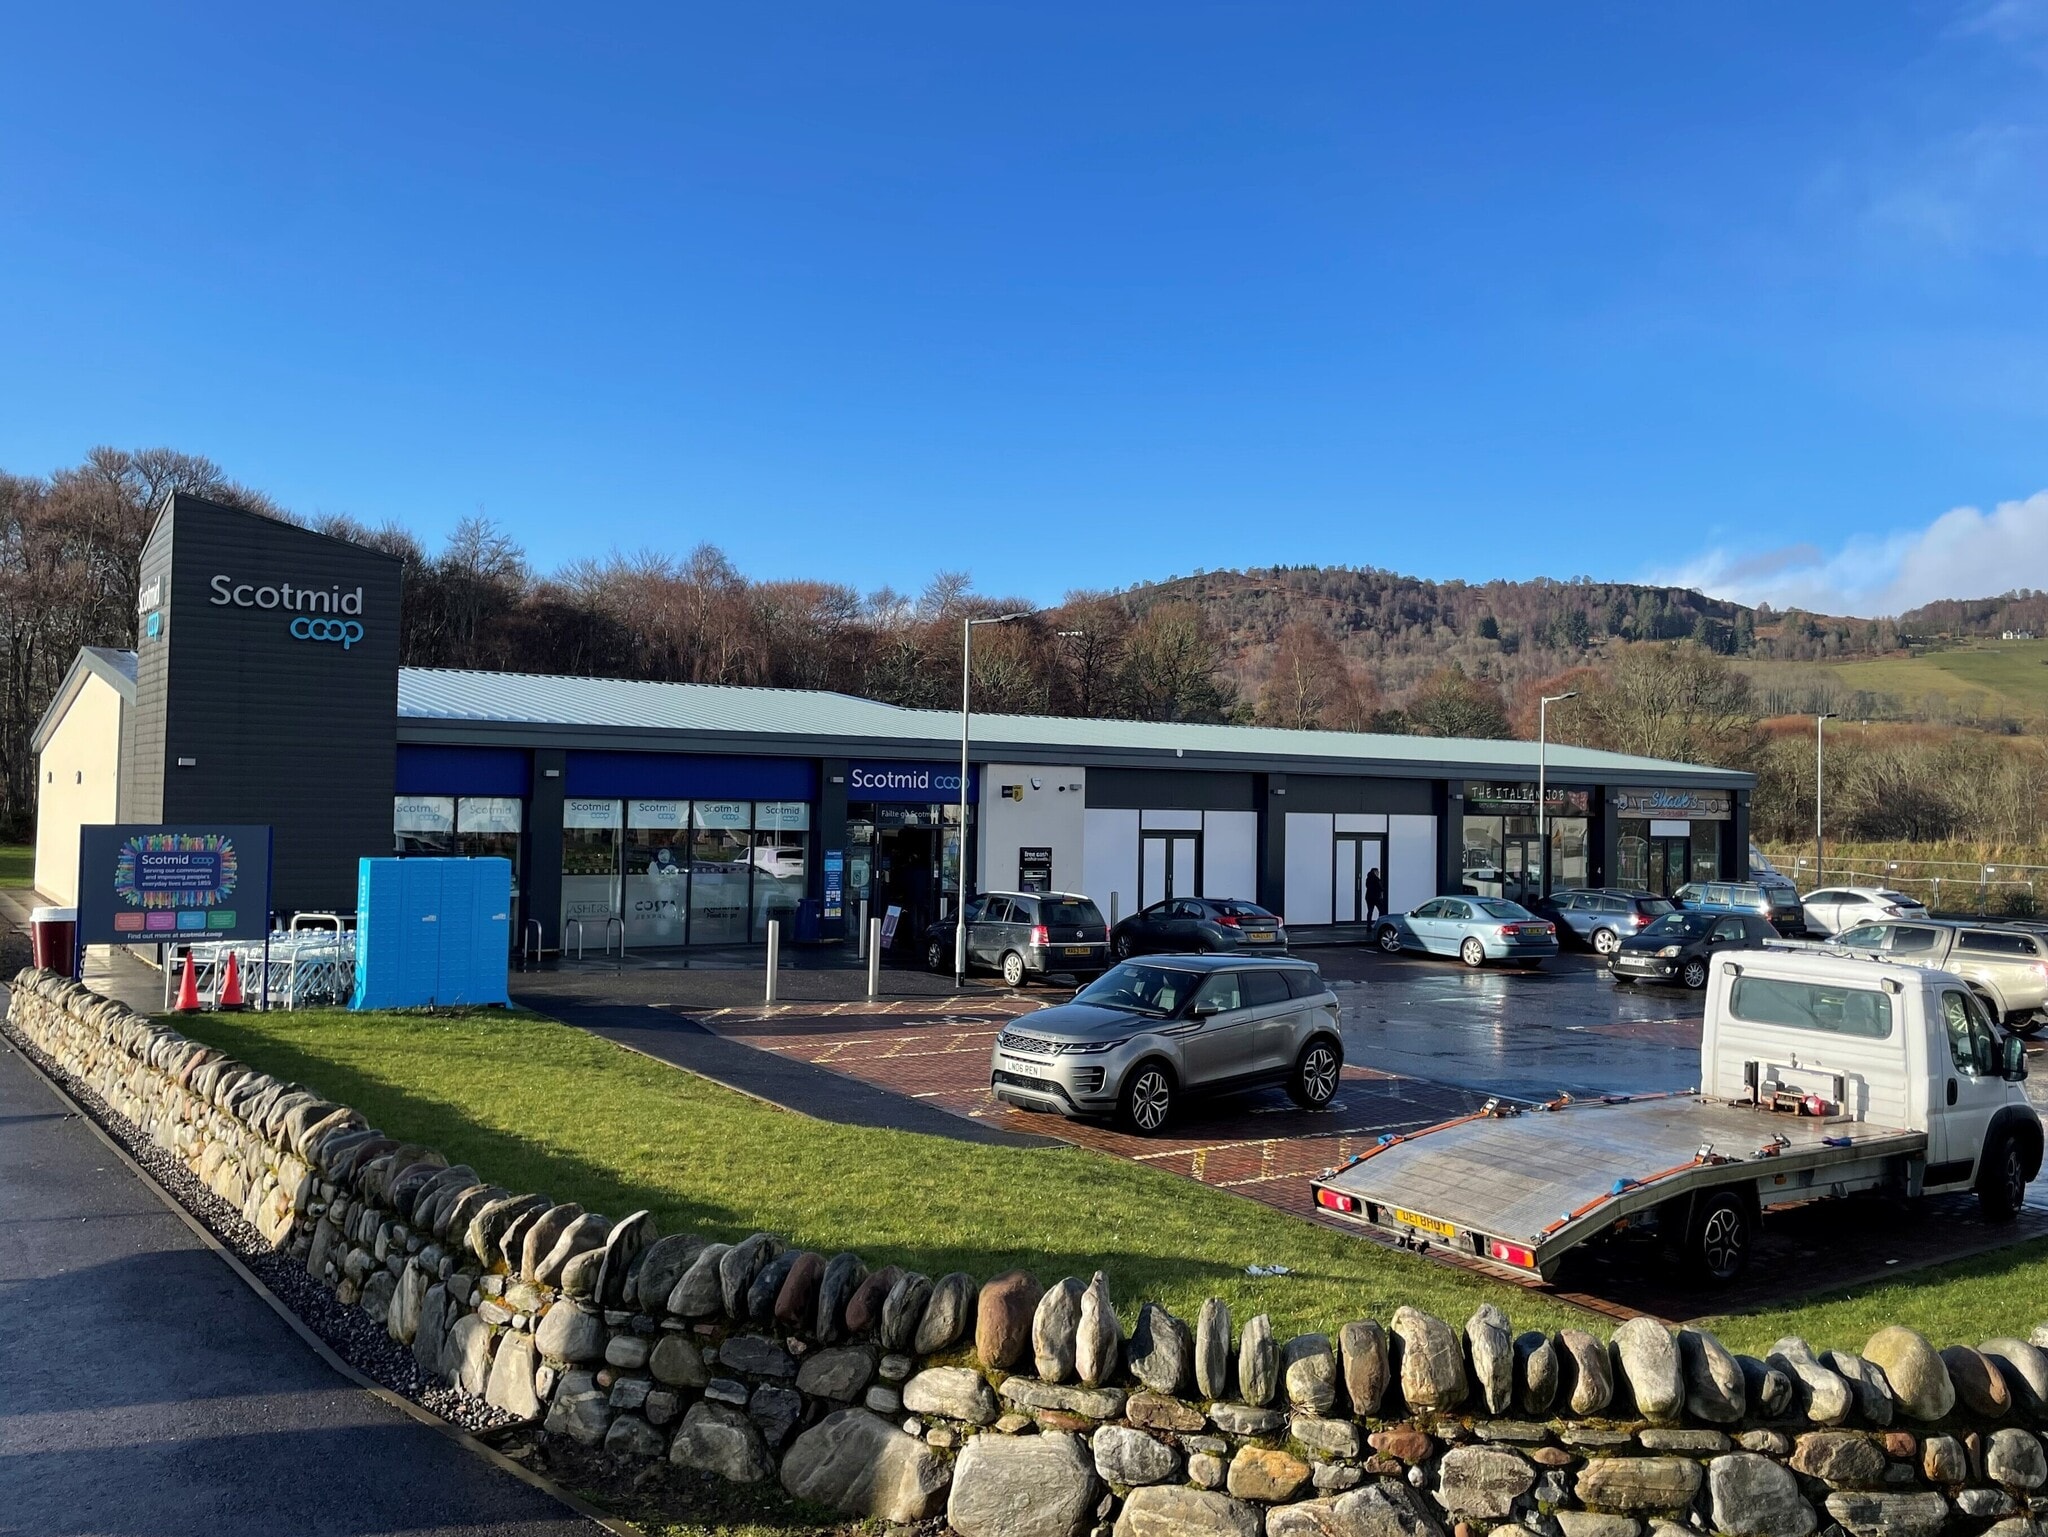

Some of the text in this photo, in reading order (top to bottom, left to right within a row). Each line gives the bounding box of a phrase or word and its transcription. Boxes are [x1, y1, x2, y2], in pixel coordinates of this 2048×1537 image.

[209, 574, 363, 615] Scotmid
[289, 616, 365, 651] coop
[851, 768, 929, 789] Scotmid
[1472, 785, 1565, 801] THE ITALIAN JOB
[571, 802, 611, 811] Scotmid
[639, 802, 677, 812] Scotmid
[765, 805, 800, 815] Scotmid
[881, 810, 899, 818] Fàilte
[910, 810, 937, 818] Scotm
[141, 854, 215, 867] Scotmid coop
[569, 904, 609, 914] ASHERS
[179, 931, 223, 939] scotmid.coop
[1008, 1061, 1039, 1076] LN06 REN
